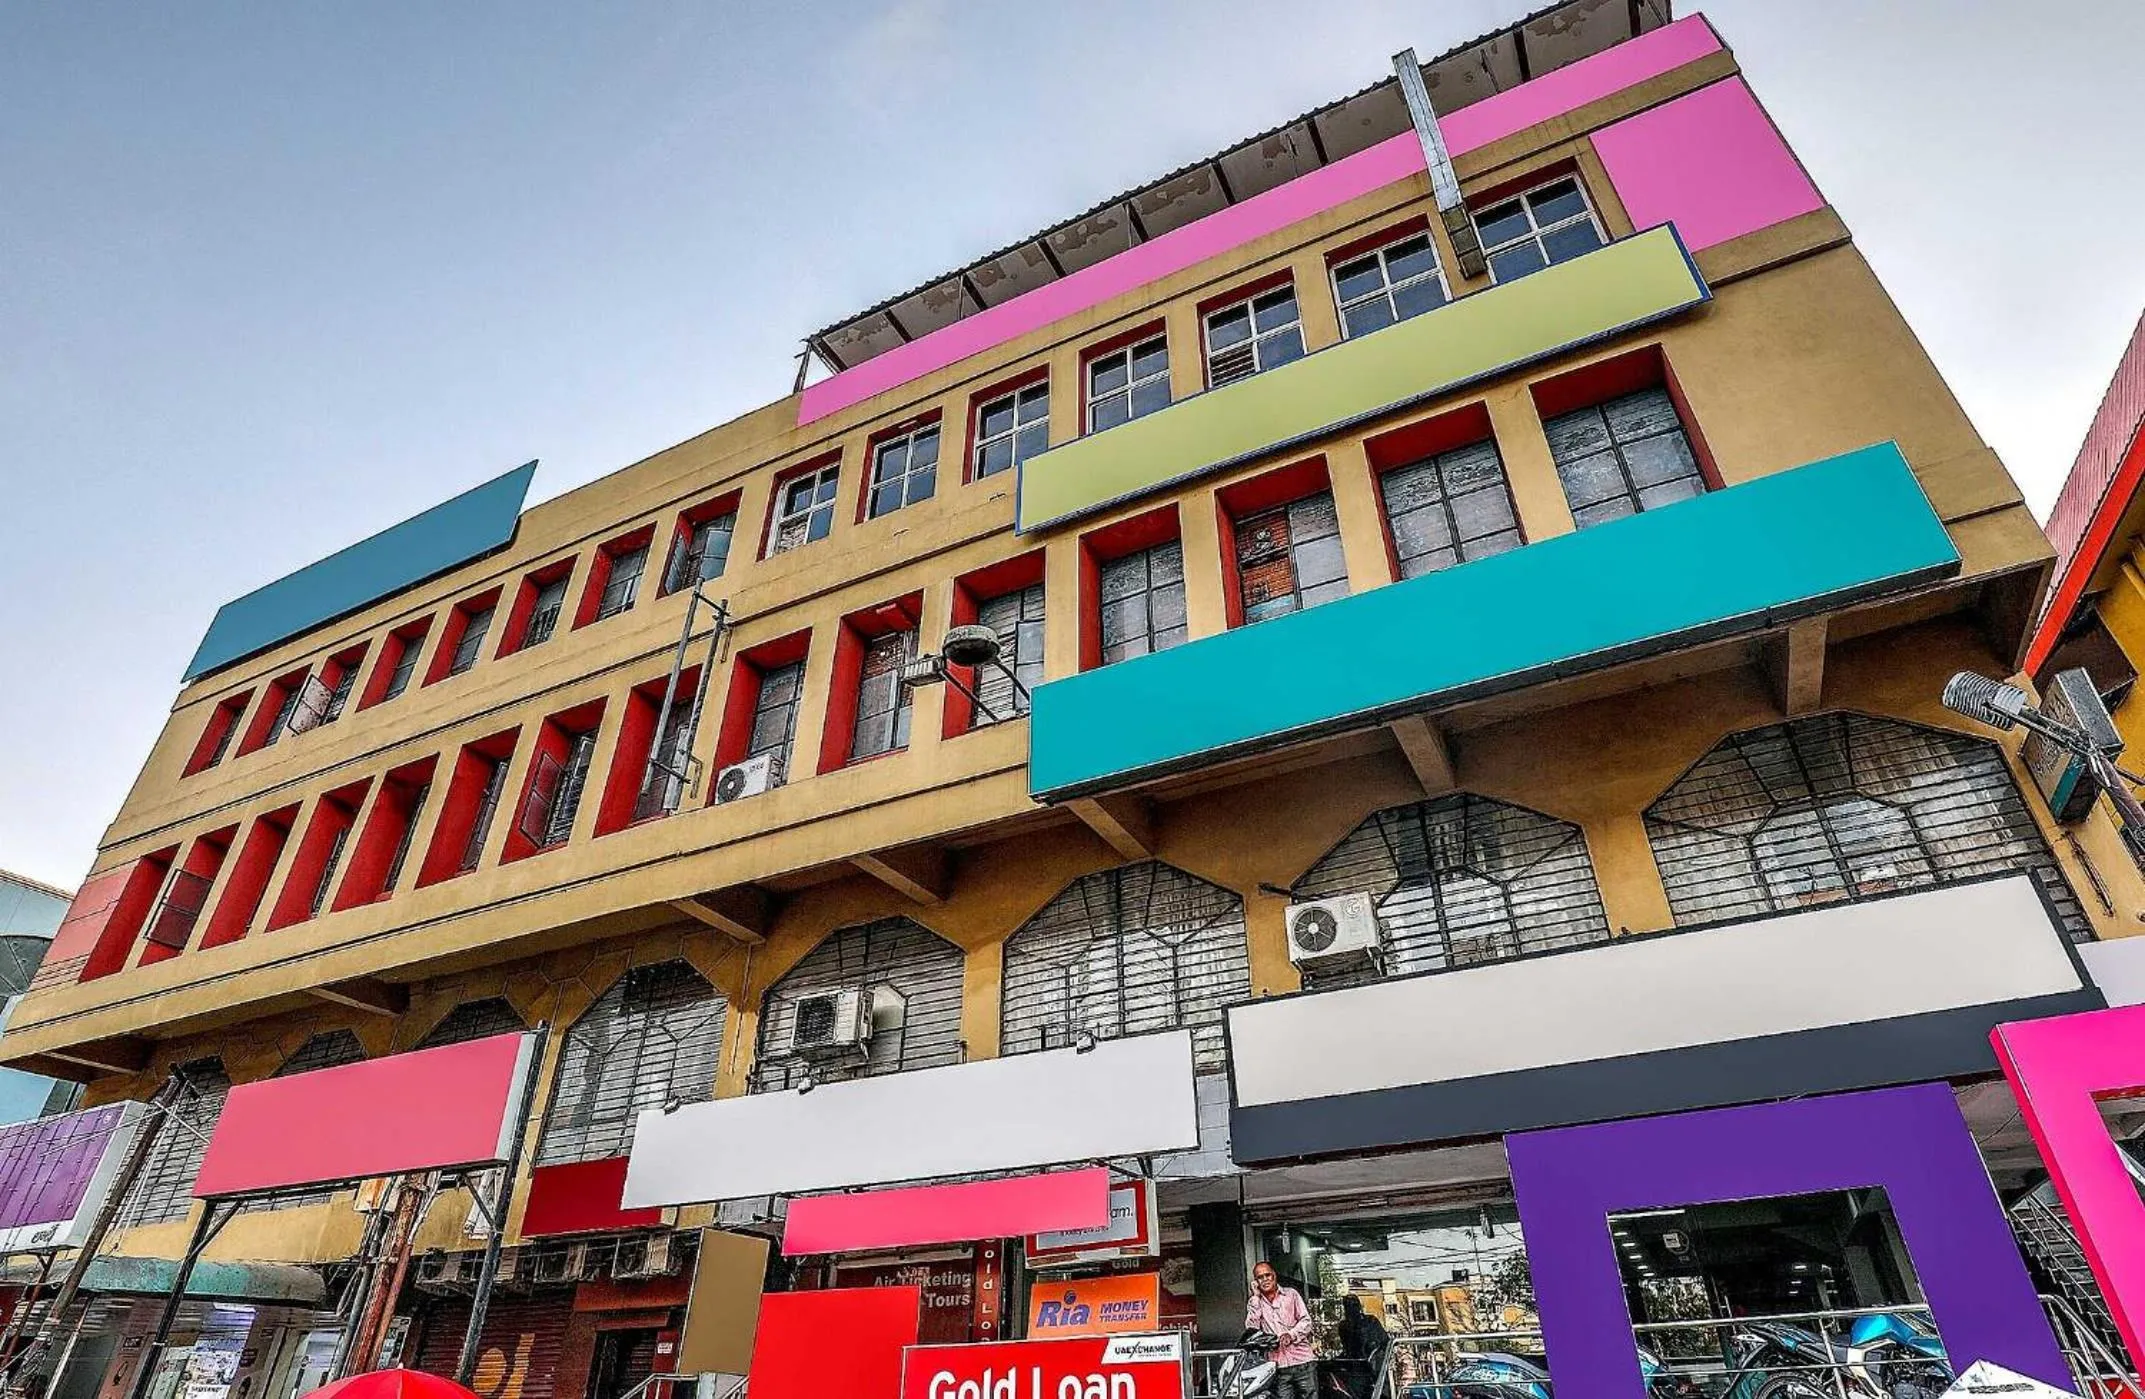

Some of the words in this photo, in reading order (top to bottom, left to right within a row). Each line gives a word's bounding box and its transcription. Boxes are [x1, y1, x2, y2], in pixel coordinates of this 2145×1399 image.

[983, 1239, 995, 1290] old
[925, 1293, 971, 1308] Tours
[1037, 1290, 1091, 1328] Ria
[1101, 1300, 1149, 1314] MONEY
[1100, 1313, 1148, 1323] TRANSFER
[929, 1366, 1017, 1399] Gold
[1032, 1366, 1136, 1399] Loan
